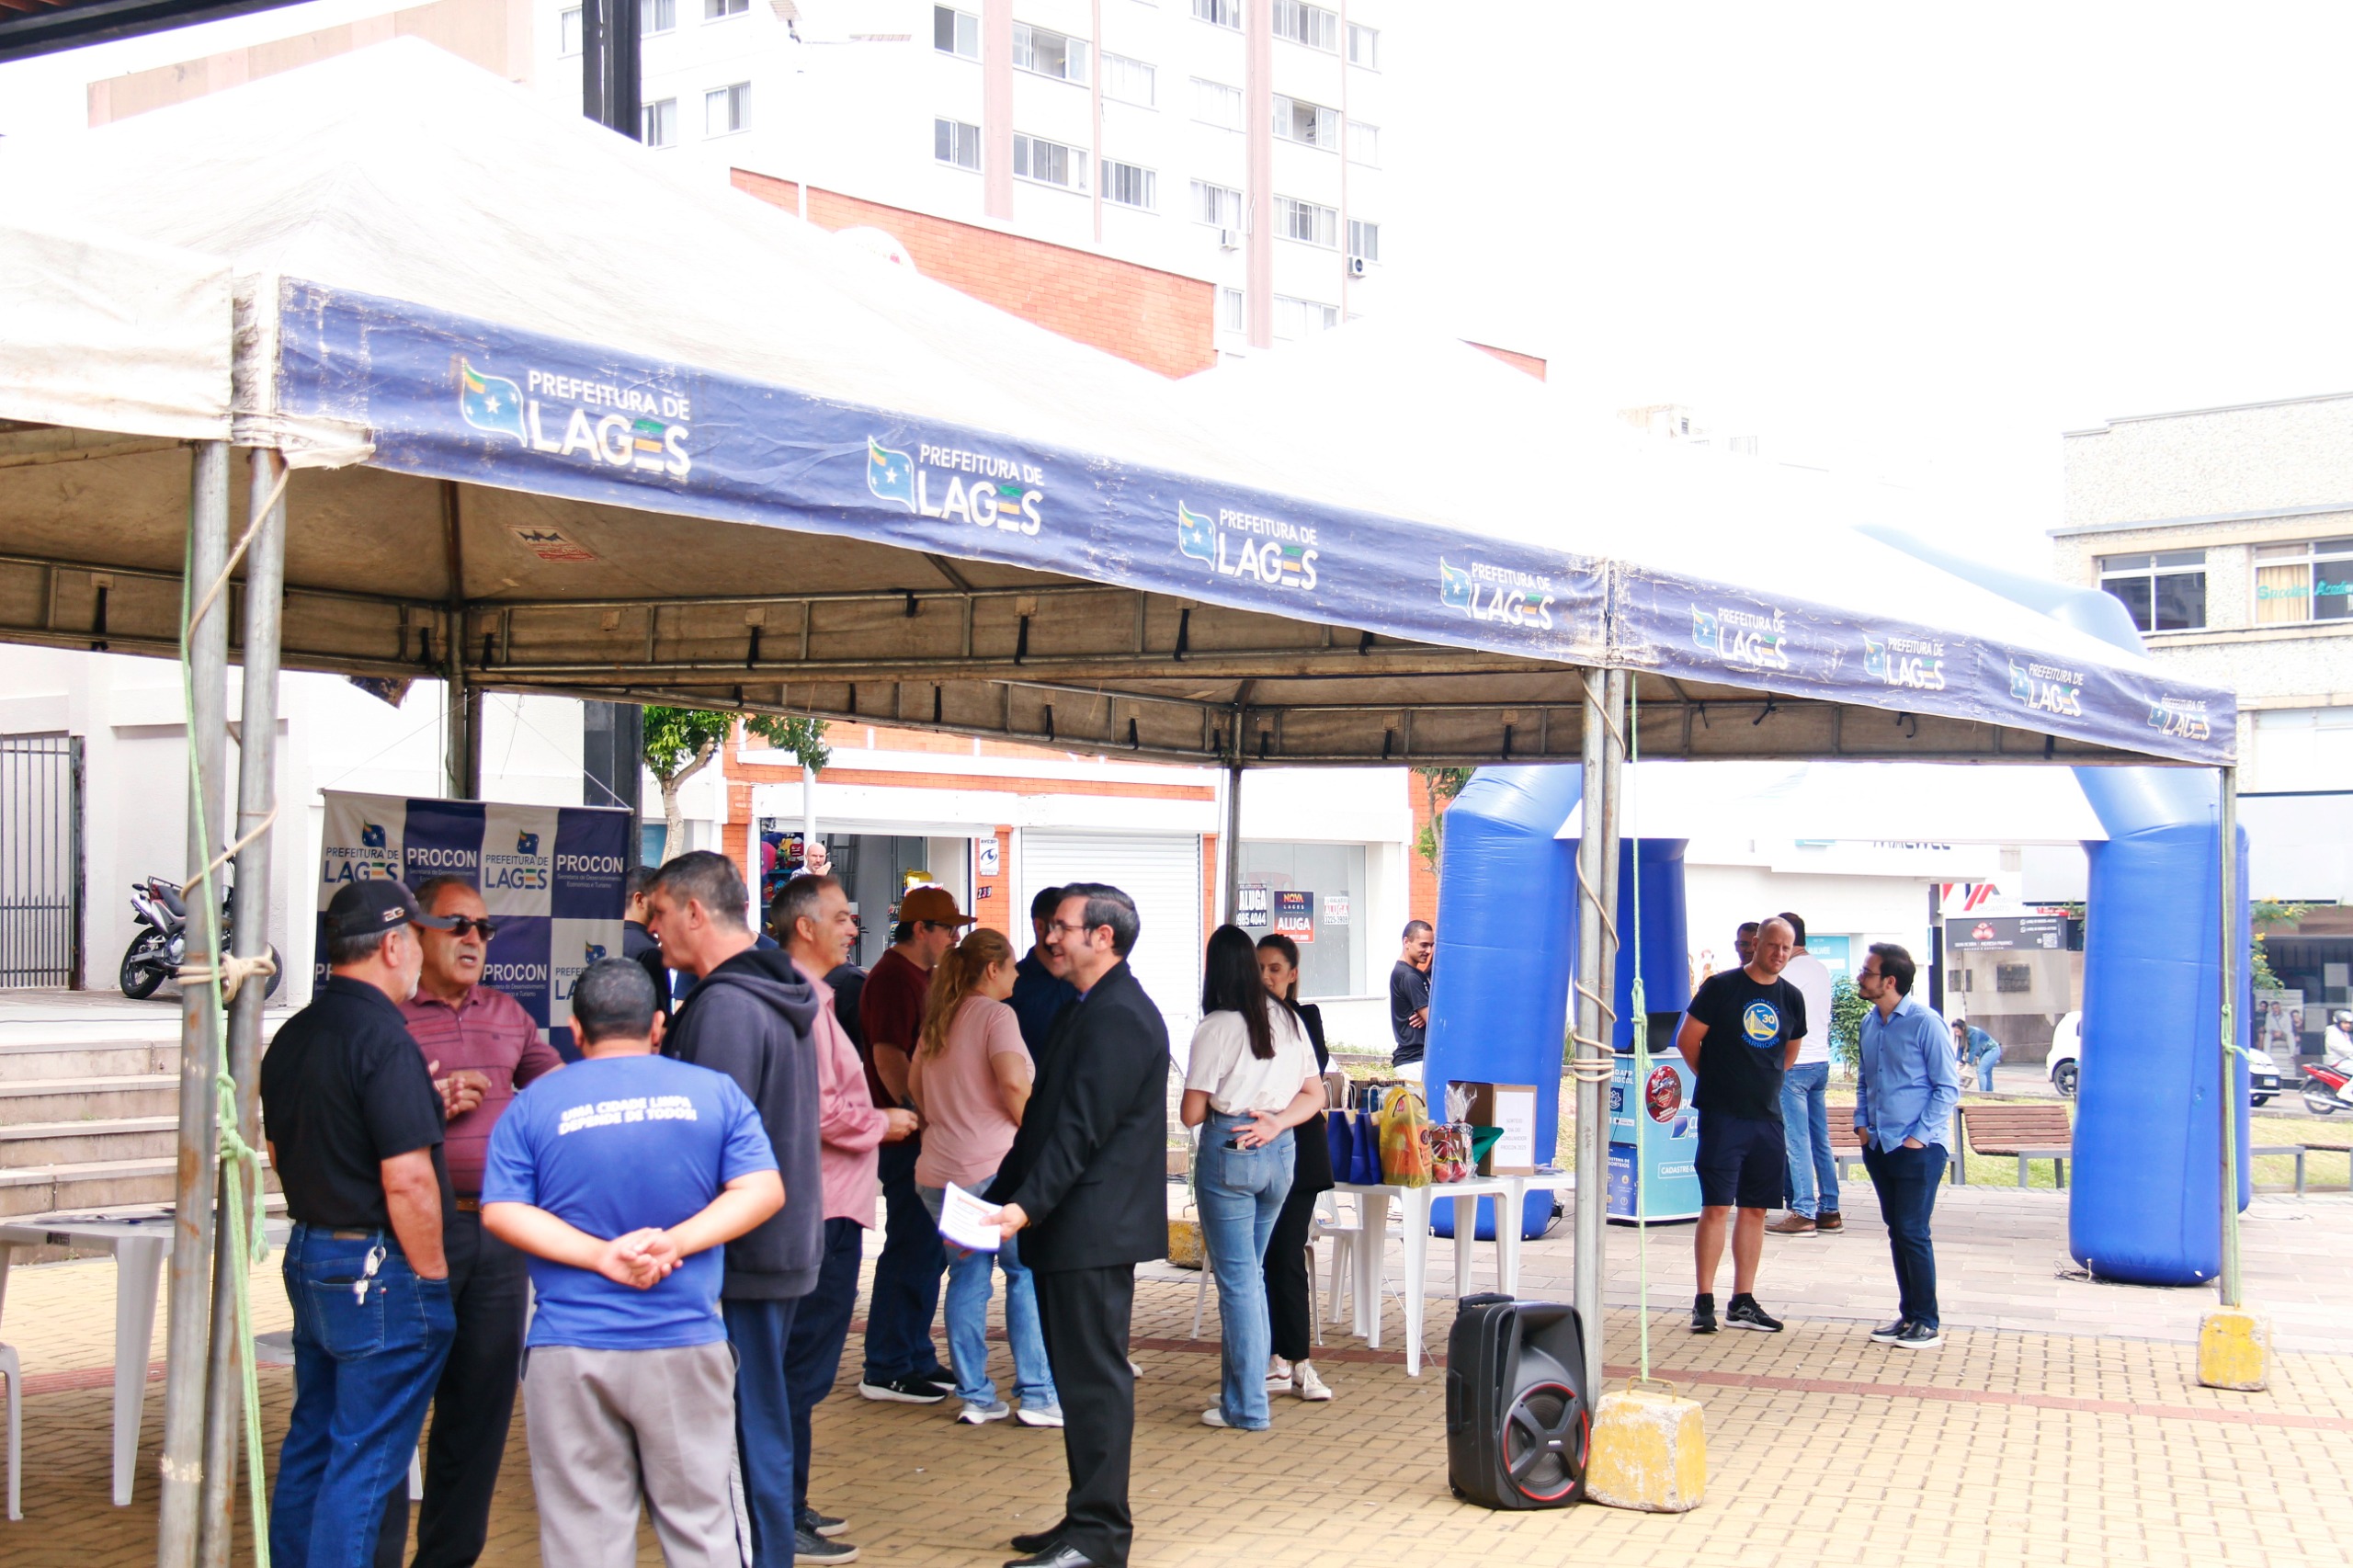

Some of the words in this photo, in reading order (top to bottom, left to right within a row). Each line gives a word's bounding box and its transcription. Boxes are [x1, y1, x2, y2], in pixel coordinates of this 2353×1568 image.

[528, 369, 659, 415] PREFEITURA
[663, 396, 691, 421] DE
[529, 399, 691, 476] LAGES
[920, 444, 1020, 481] PREFEITURA
[1022, 464, 1045, 486] DE
[918, 470, 1044, 537] LAGES
[1220, 508, 1299, 542] PREFEITURA
[1300, 527, 1319, 546] DE
[1218, 532, 1319, 591] LAGES
[1472, 562, 1536, 589] PREFEITURA
[1536, 575, 1553, 592] DE
[1471, 583, 1555, 631] LAGES
[1718, 607, 1772, 631] PREFEITURA
[1773, 619, 1787, 633] DE
[1719, 626, 1789, 670] LAGES
[1887, 636, 1932, 656] PREFEITURA
[1933, 642, 1945, 657] DE
[1886, 653, 1946, 691] LAGES
[2029, 663, 2072, 684] PREFEITURA
[2072, 672, 2084, 687] DE
[2028, 679, 2082, 717] LAGES
[326, 846, 384, 859] PREFEITURA
[387, 849, 400, 860] DE
[407, 847, 477, 868] PROCON
[485, 854, 535, 865] PREFEITURA
[537, 857, 549, 867] DE
[556, 854, 624, 873] PROCON
[324, 860, 399, 883] LAGES
[485, 868, 548, 891] LAGES
[1238, 889, 1267, 911] ALUGA
[1283, 893, 1303, 903] NOVA
[1324, 905, 1348, 915] ALUGA
[1277, 917, 1311, 931] ALUGA
[483, 963, 547, 982] PROCON
[1761, 1014, 1775, 1024] 30
[1741, 1031, 1779, 1049] WARRIORS
[562, 1104, 594, 1121] UMA
[597, 1097, 647, 1113] CIDADE
[650, 1096, 692, 1108] LIMPA
[558, 1111, 623, 1136] DEPENDE
[624, 1108, 645, 1123] DE
